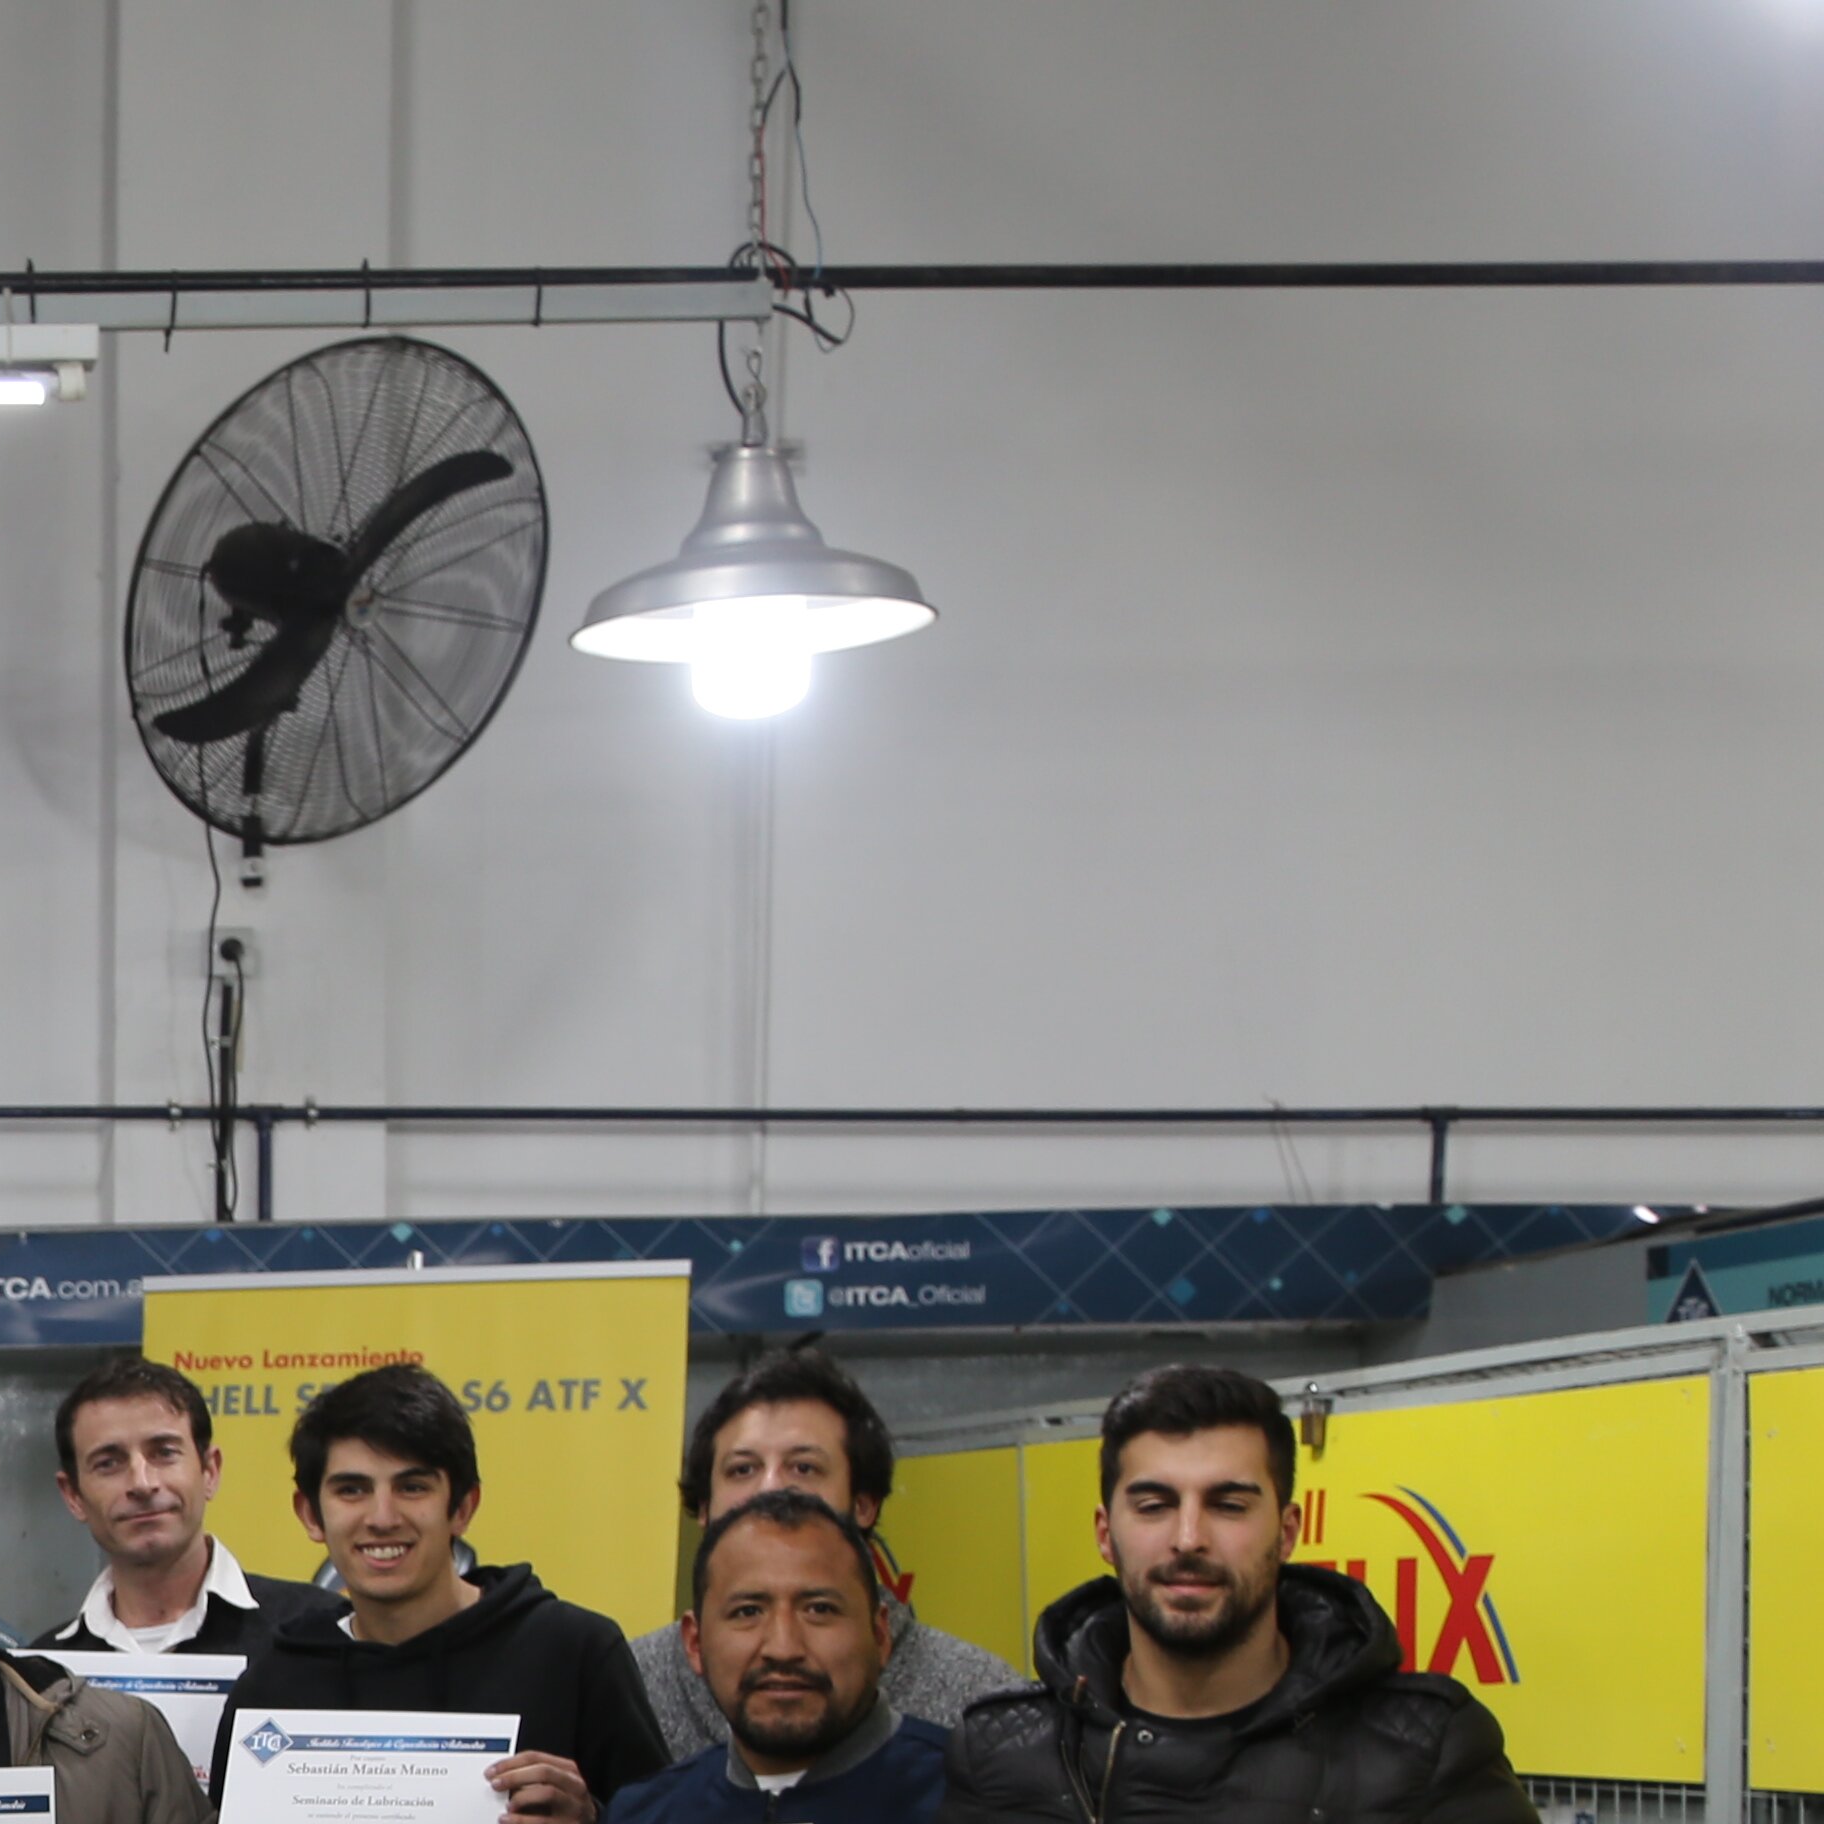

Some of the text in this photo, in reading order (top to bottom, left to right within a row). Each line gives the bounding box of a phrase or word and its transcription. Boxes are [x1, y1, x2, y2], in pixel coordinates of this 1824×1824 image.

[174, 1347, 423, 1371] Nuevo Lanzamiento
[199, 1385, 279, 1416] HELL
[464, 1380, 510, 1412] S6
[526, 1379, 601, 1411] ATF
[617, 1378, 648, 1410] X
[287, 1762, 448, 1776] Sebastián Matías Manno
[292, 1794, 434, 1808] Seminario de Lubricación
